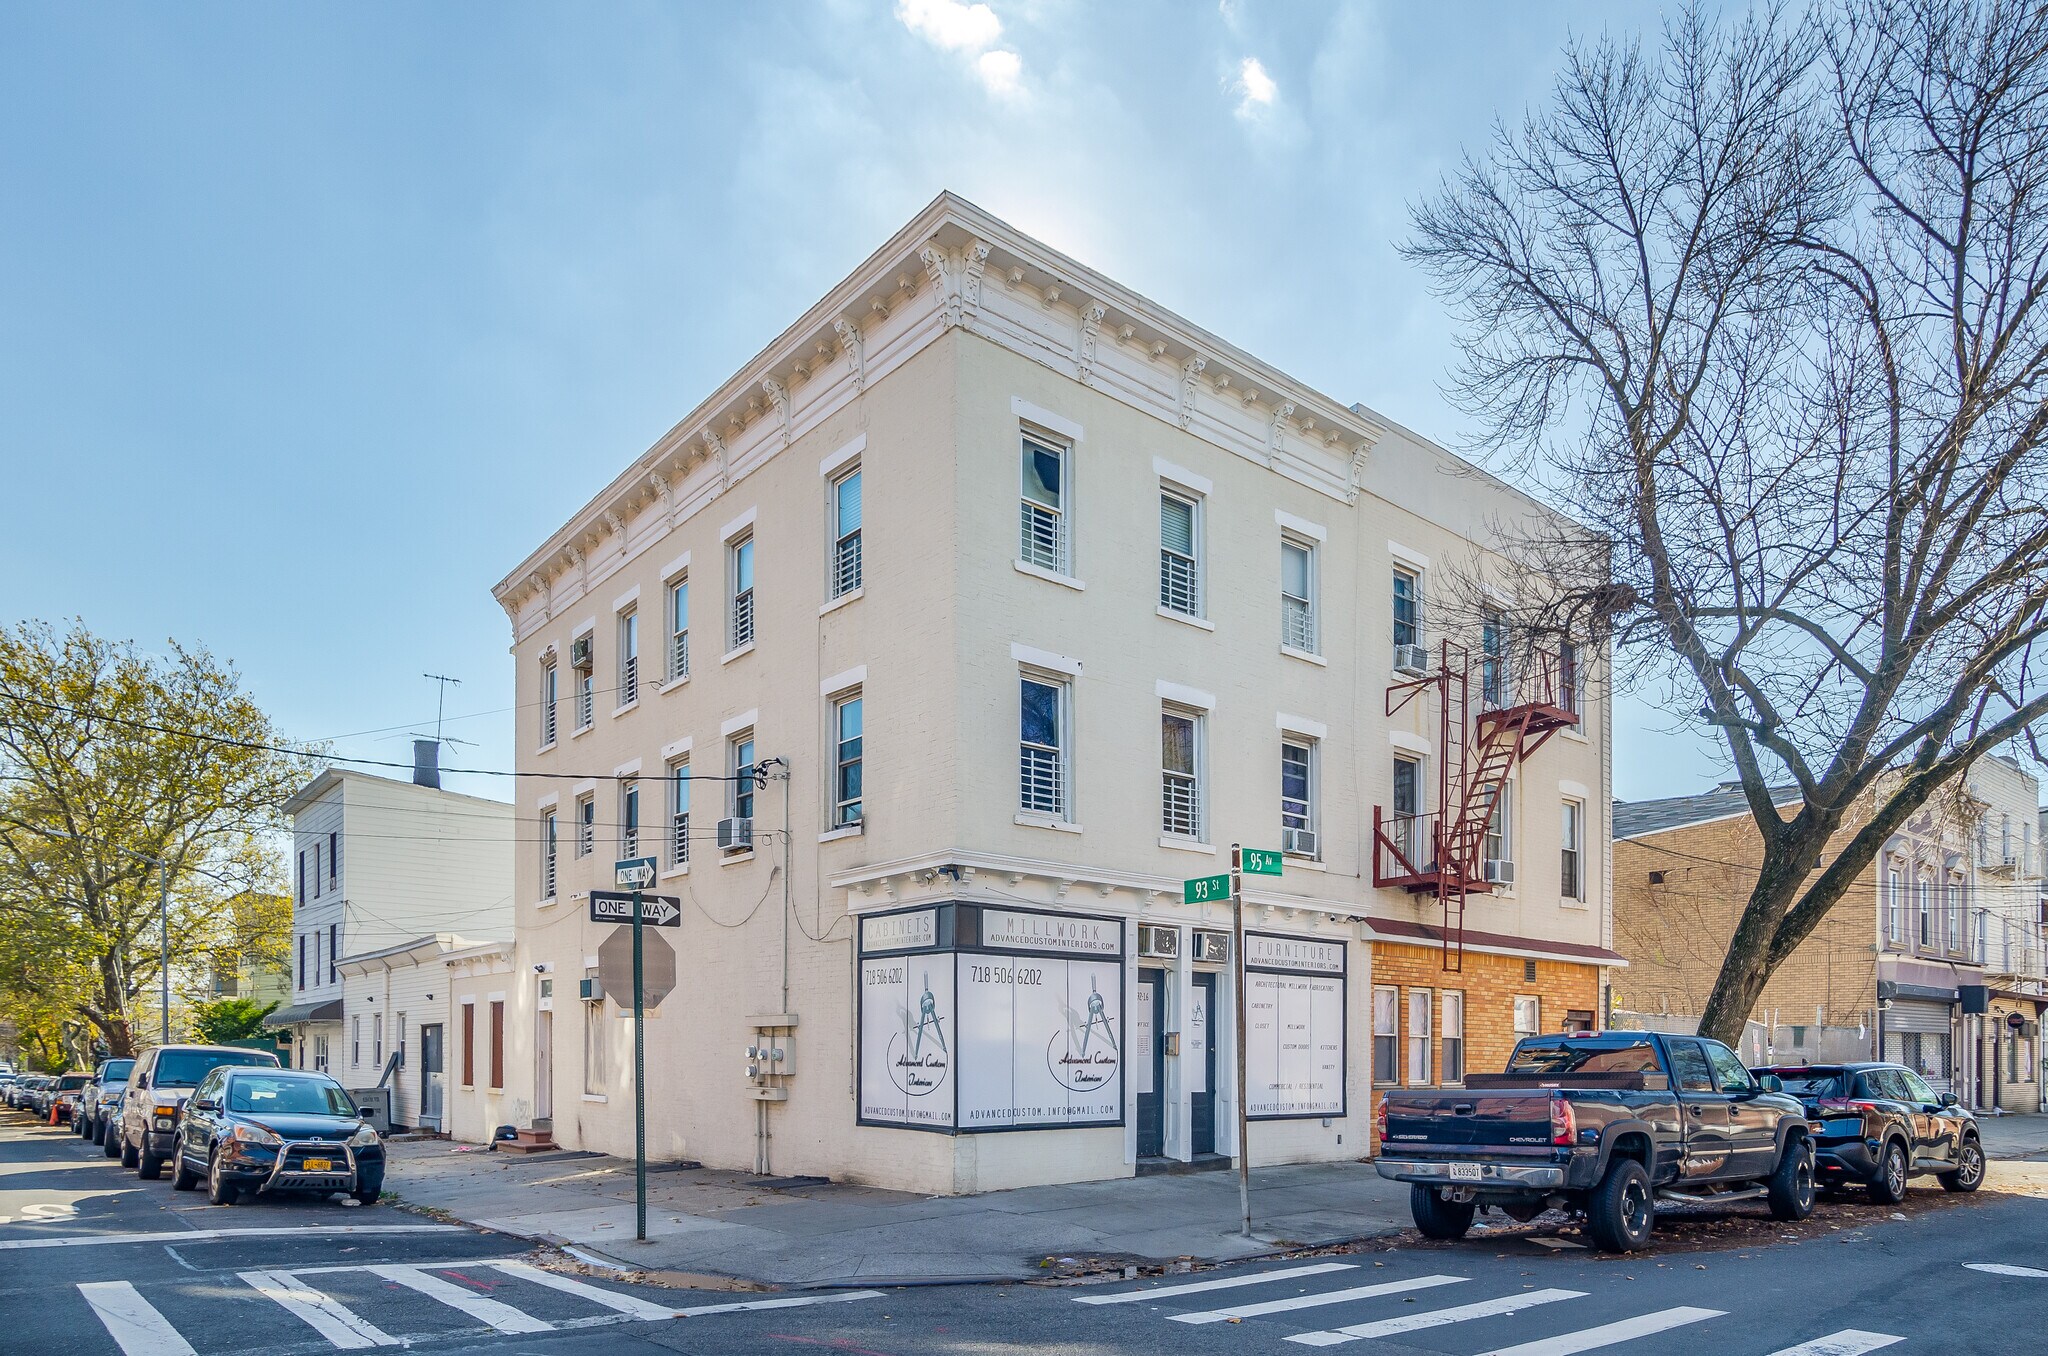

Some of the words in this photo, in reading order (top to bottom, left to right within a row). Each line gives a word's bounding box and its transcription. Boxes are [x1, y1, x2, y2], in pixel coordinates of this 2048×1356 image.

[1250, 852, 1262, 871] 95
[1265, 854, 1272, 866] Av
[620, 869, 632, 883] ONE
[637, 866, 650, 880] WAY
[1195, 880, 1208, 899] 93
[1212, 879, 1220, 891] St
[598, 901, 626, 914] ONE
[641, 903, 670, 917] WAY
[868, 916, 930, 939] CABINETS
[1007, 918, 1101, 940] MILLWORK
[990, 933, 1115, 950] ADVANCEDCUSTOMINTERIORS.COM
[1257, 941, 1332, 960] FURNITURE
[1250, 957, 1340, 970] ADVANCEDCUSTOMINTERIORS.COM
[866, 969, 876, 985] 718
[877, 968, 888, 985] 506
[888, 967, 903, 984] 6202
[971, 965, 991, 983] 718
[994, 967, 1013, 984] 506
[1017, 968, 1042, 985] 6202
[1288, 982, 1308, 990] MILLWORK
[925, 1053, 946, 1068] Custom
[1058, 1050, 1093, 1065] Advanced
[1094, 1050, 1116, 1065] Custom
[970, 1105, 1114, 1120] ADVANCEDCUSTOM.INFO@GMAIL.COM
